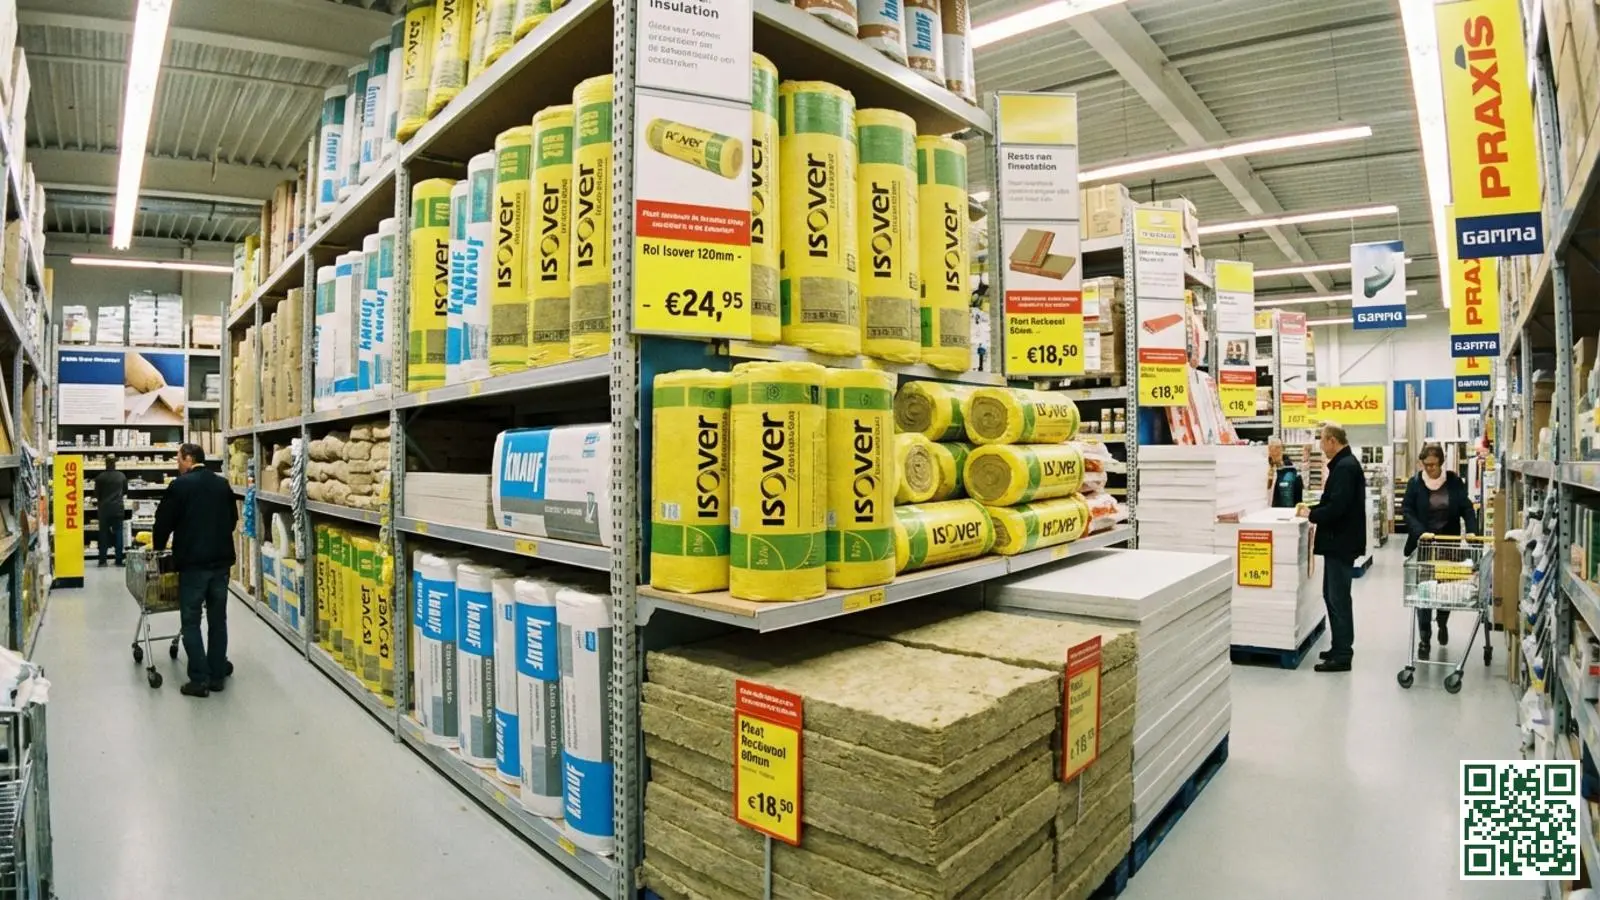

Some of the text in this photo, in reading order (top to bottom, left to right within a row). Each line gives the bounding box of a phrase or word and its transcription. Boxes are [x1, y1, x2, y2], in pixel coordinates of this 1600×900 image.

[1463, 15, 1511, 198] PRAXIS
[643, 243, 660, 256] Rol
[663, 245, 695, 259] Isover
[697, 248, 735, 261] 120mm
[665, 289, 743, 322] €24,95
[1027, 345, 1078, 366] €18,50
[748, 792, 794, 823] €18,50
